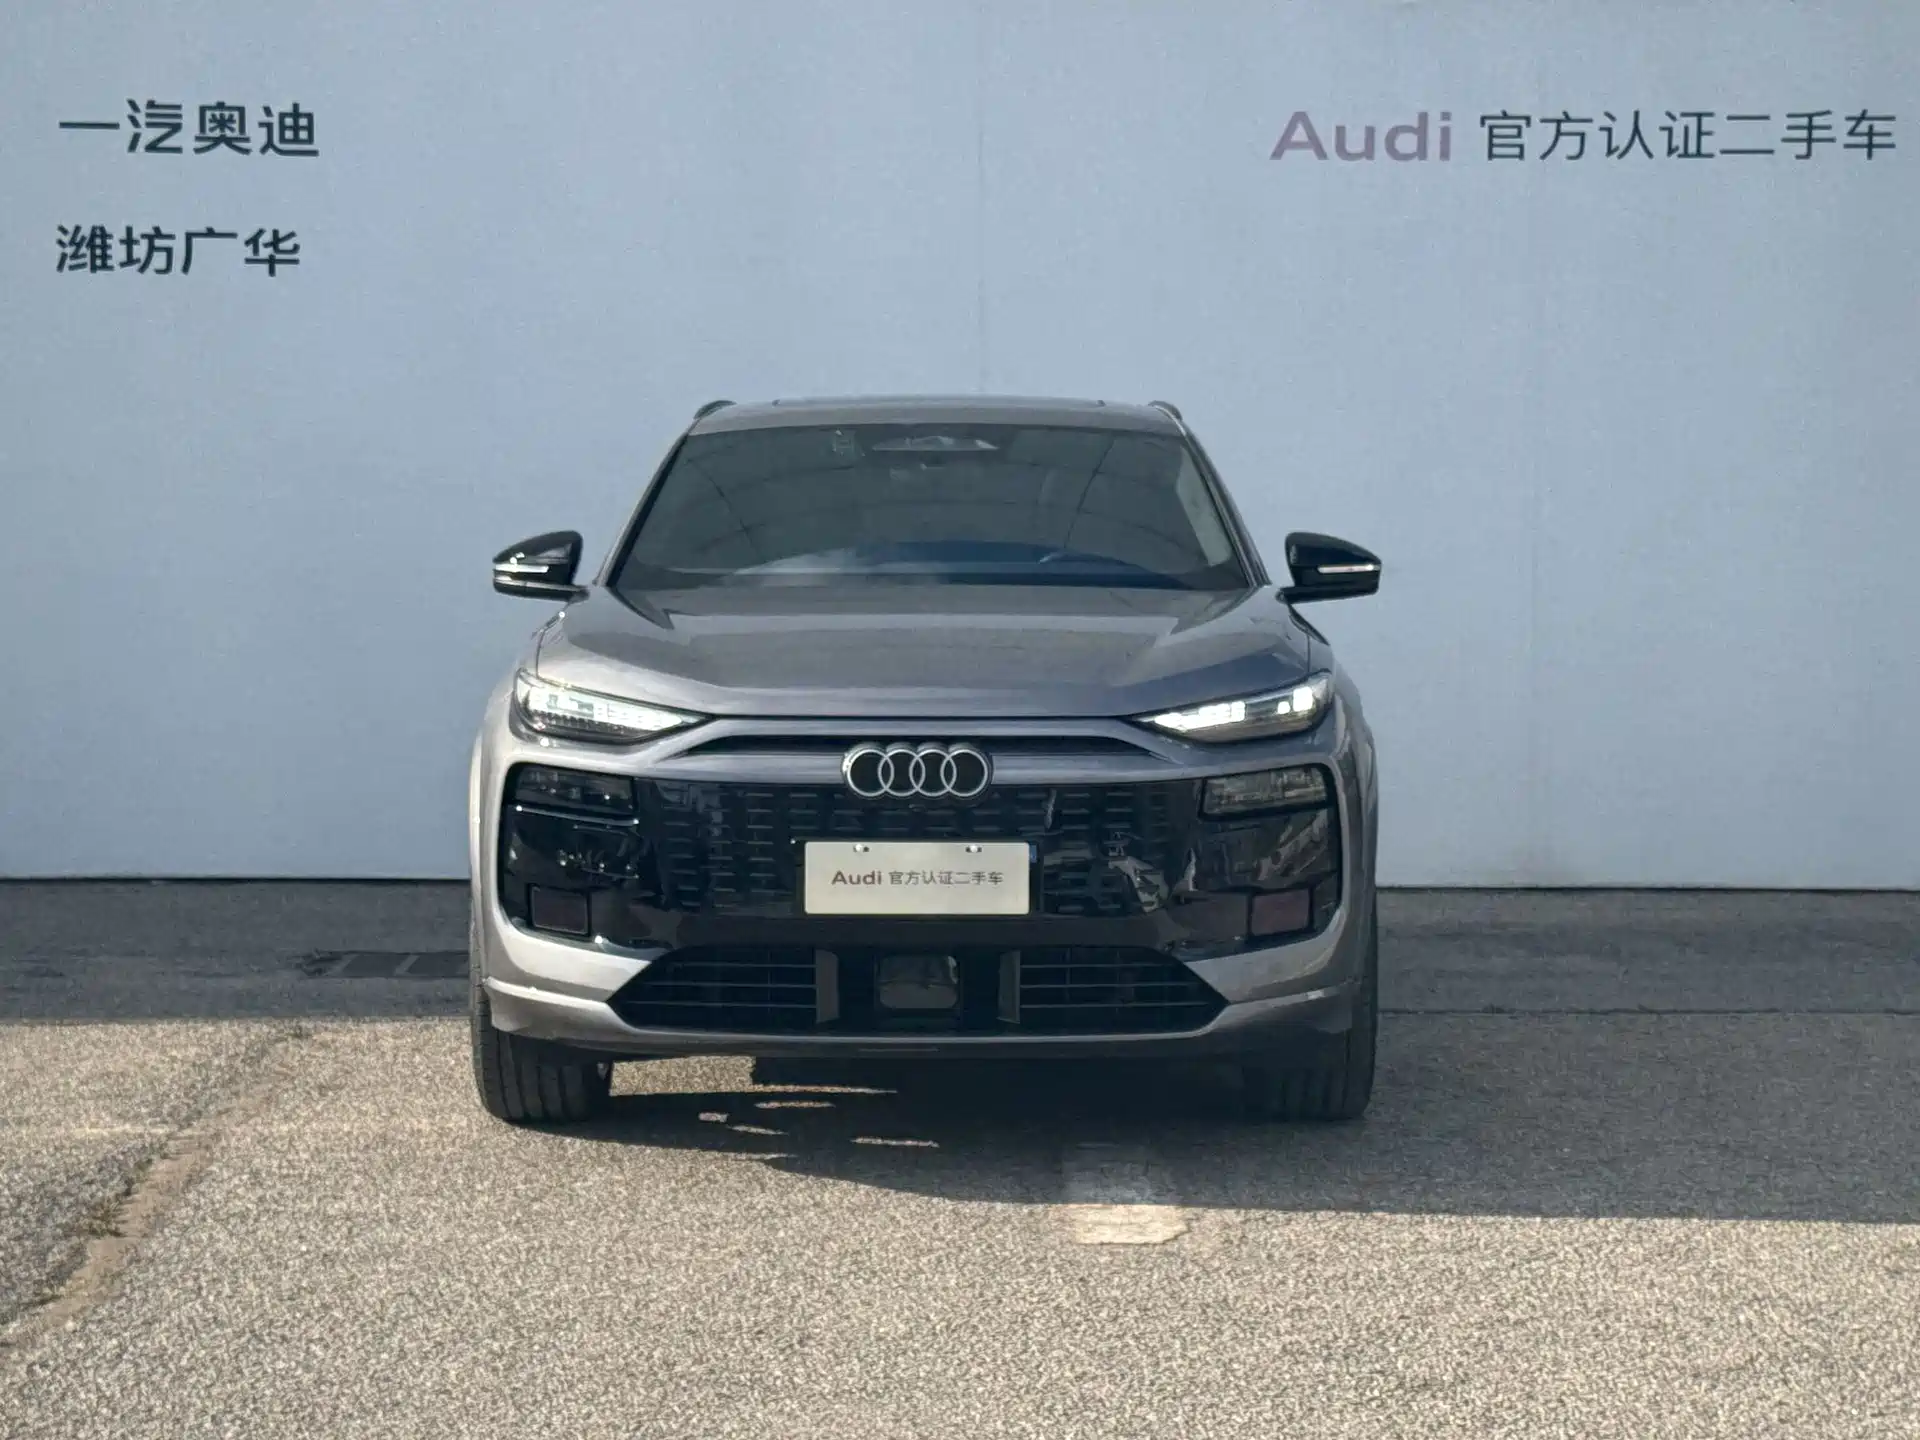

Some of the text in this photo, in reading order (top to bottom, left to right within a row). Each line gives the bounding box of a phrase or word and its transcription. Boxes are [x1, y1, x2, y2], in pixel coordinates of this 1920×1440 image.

[59, 98, 320, 157] 一汽奥迪
[1269, 110, 1897, 161] Audi 官方认证二手车
[56, 224, 301, 277] 潍坊广华
[831, 870, 1004, 886] Audi 官方认证二手车
